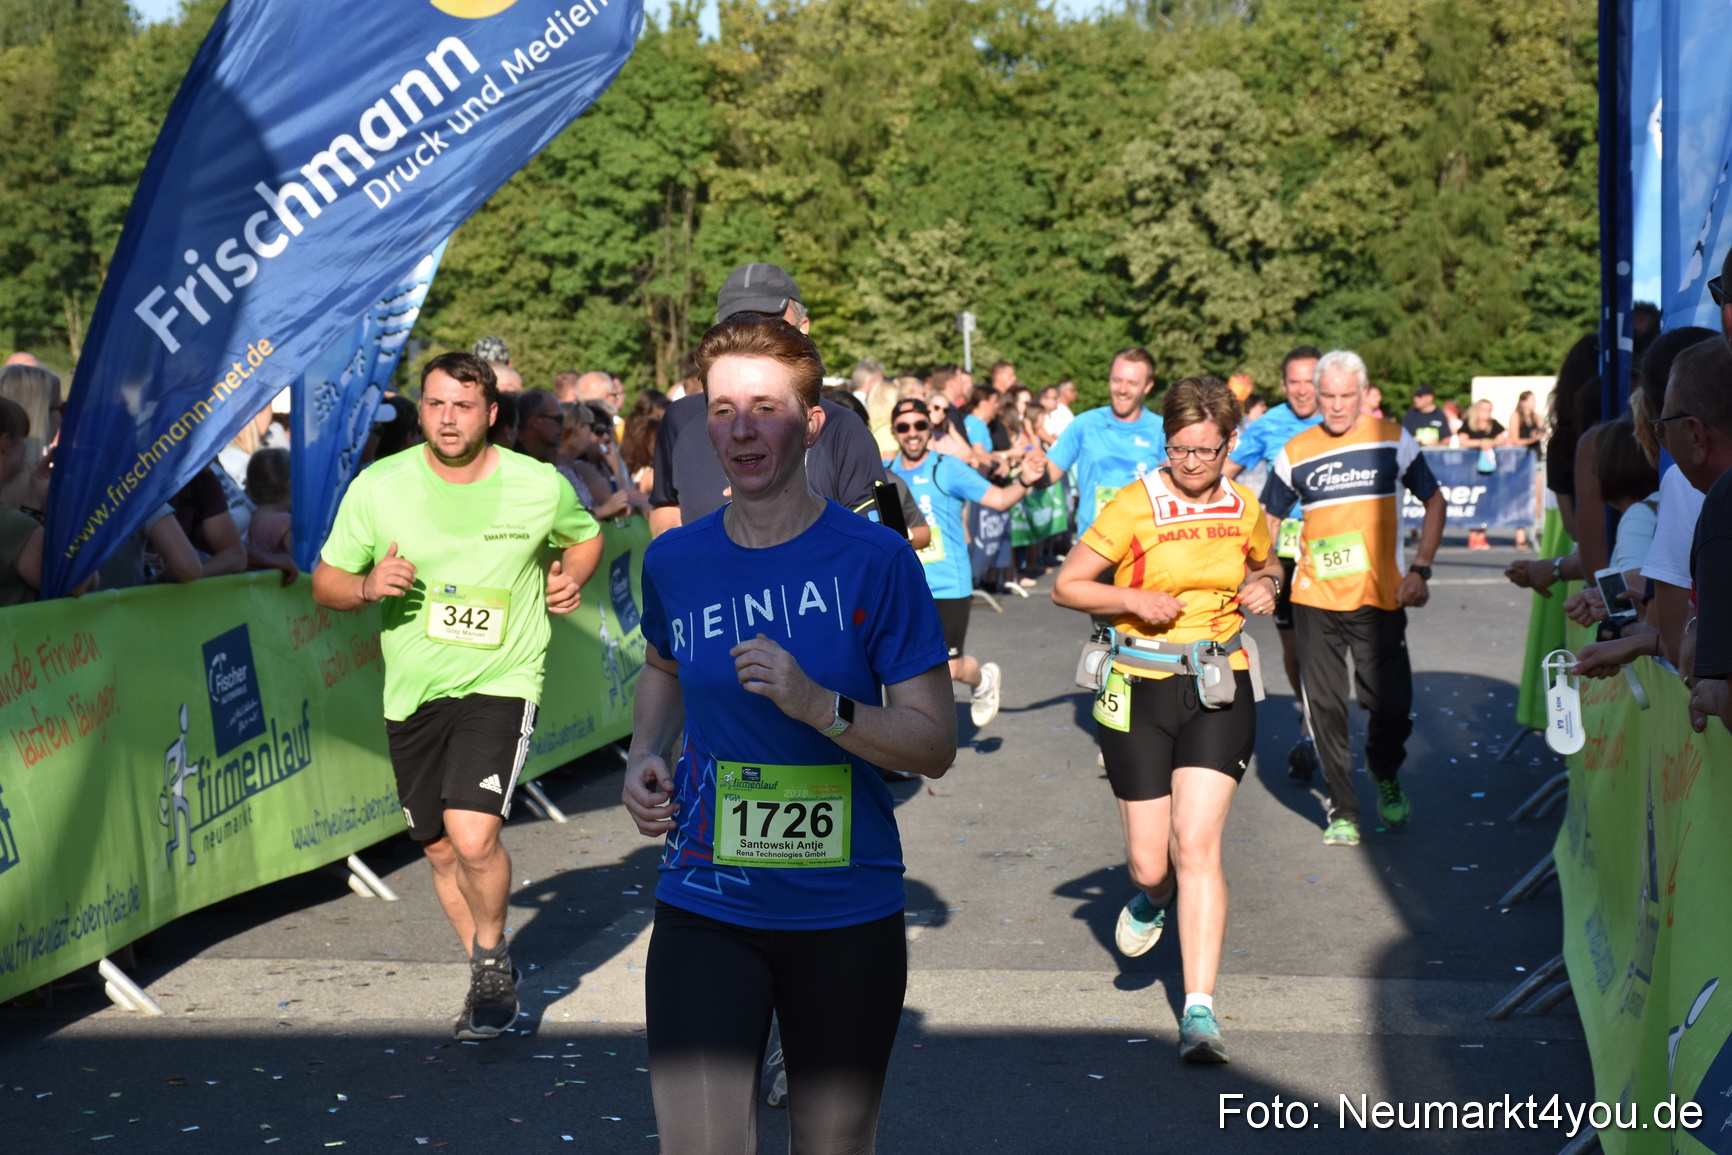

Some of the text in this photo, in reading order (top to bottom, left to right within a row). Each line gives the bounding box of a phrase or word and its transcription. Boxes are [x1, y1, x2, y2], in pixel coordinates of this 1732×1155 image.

[363, 131, 448, 209] Druck
[447, 74, 505, 135] und
[134, 36, 480, 354] Frischmann
[65, 338, 274, 559] www.frischmann-net.de
[1317, 467, 1378, 487] Fischer
[1158, 527, 1201, 544] MAX
[1323, 548, 1351, 567] 587
[443, 605, 490, 631] 342
[36, 632, 103, 685] Firmen
[215, 665, 247, 695] Fischer
[10, 705, 75, 768] laufen
[198, 699, 312, 824] firmenlauf
[479, 781, 502, 795] adidas
[732, 778, 778, 790] firmenlauf
[784, 789, 809, 798] 2018
[203, 804, 253, 852] neumarkt
[732, 800, 834, 838] 1726
[736, 849, 755, 858] Rena
[756, 850, 803, 860] Technologies
[740, 839, 824, 852] Santowski Antje
